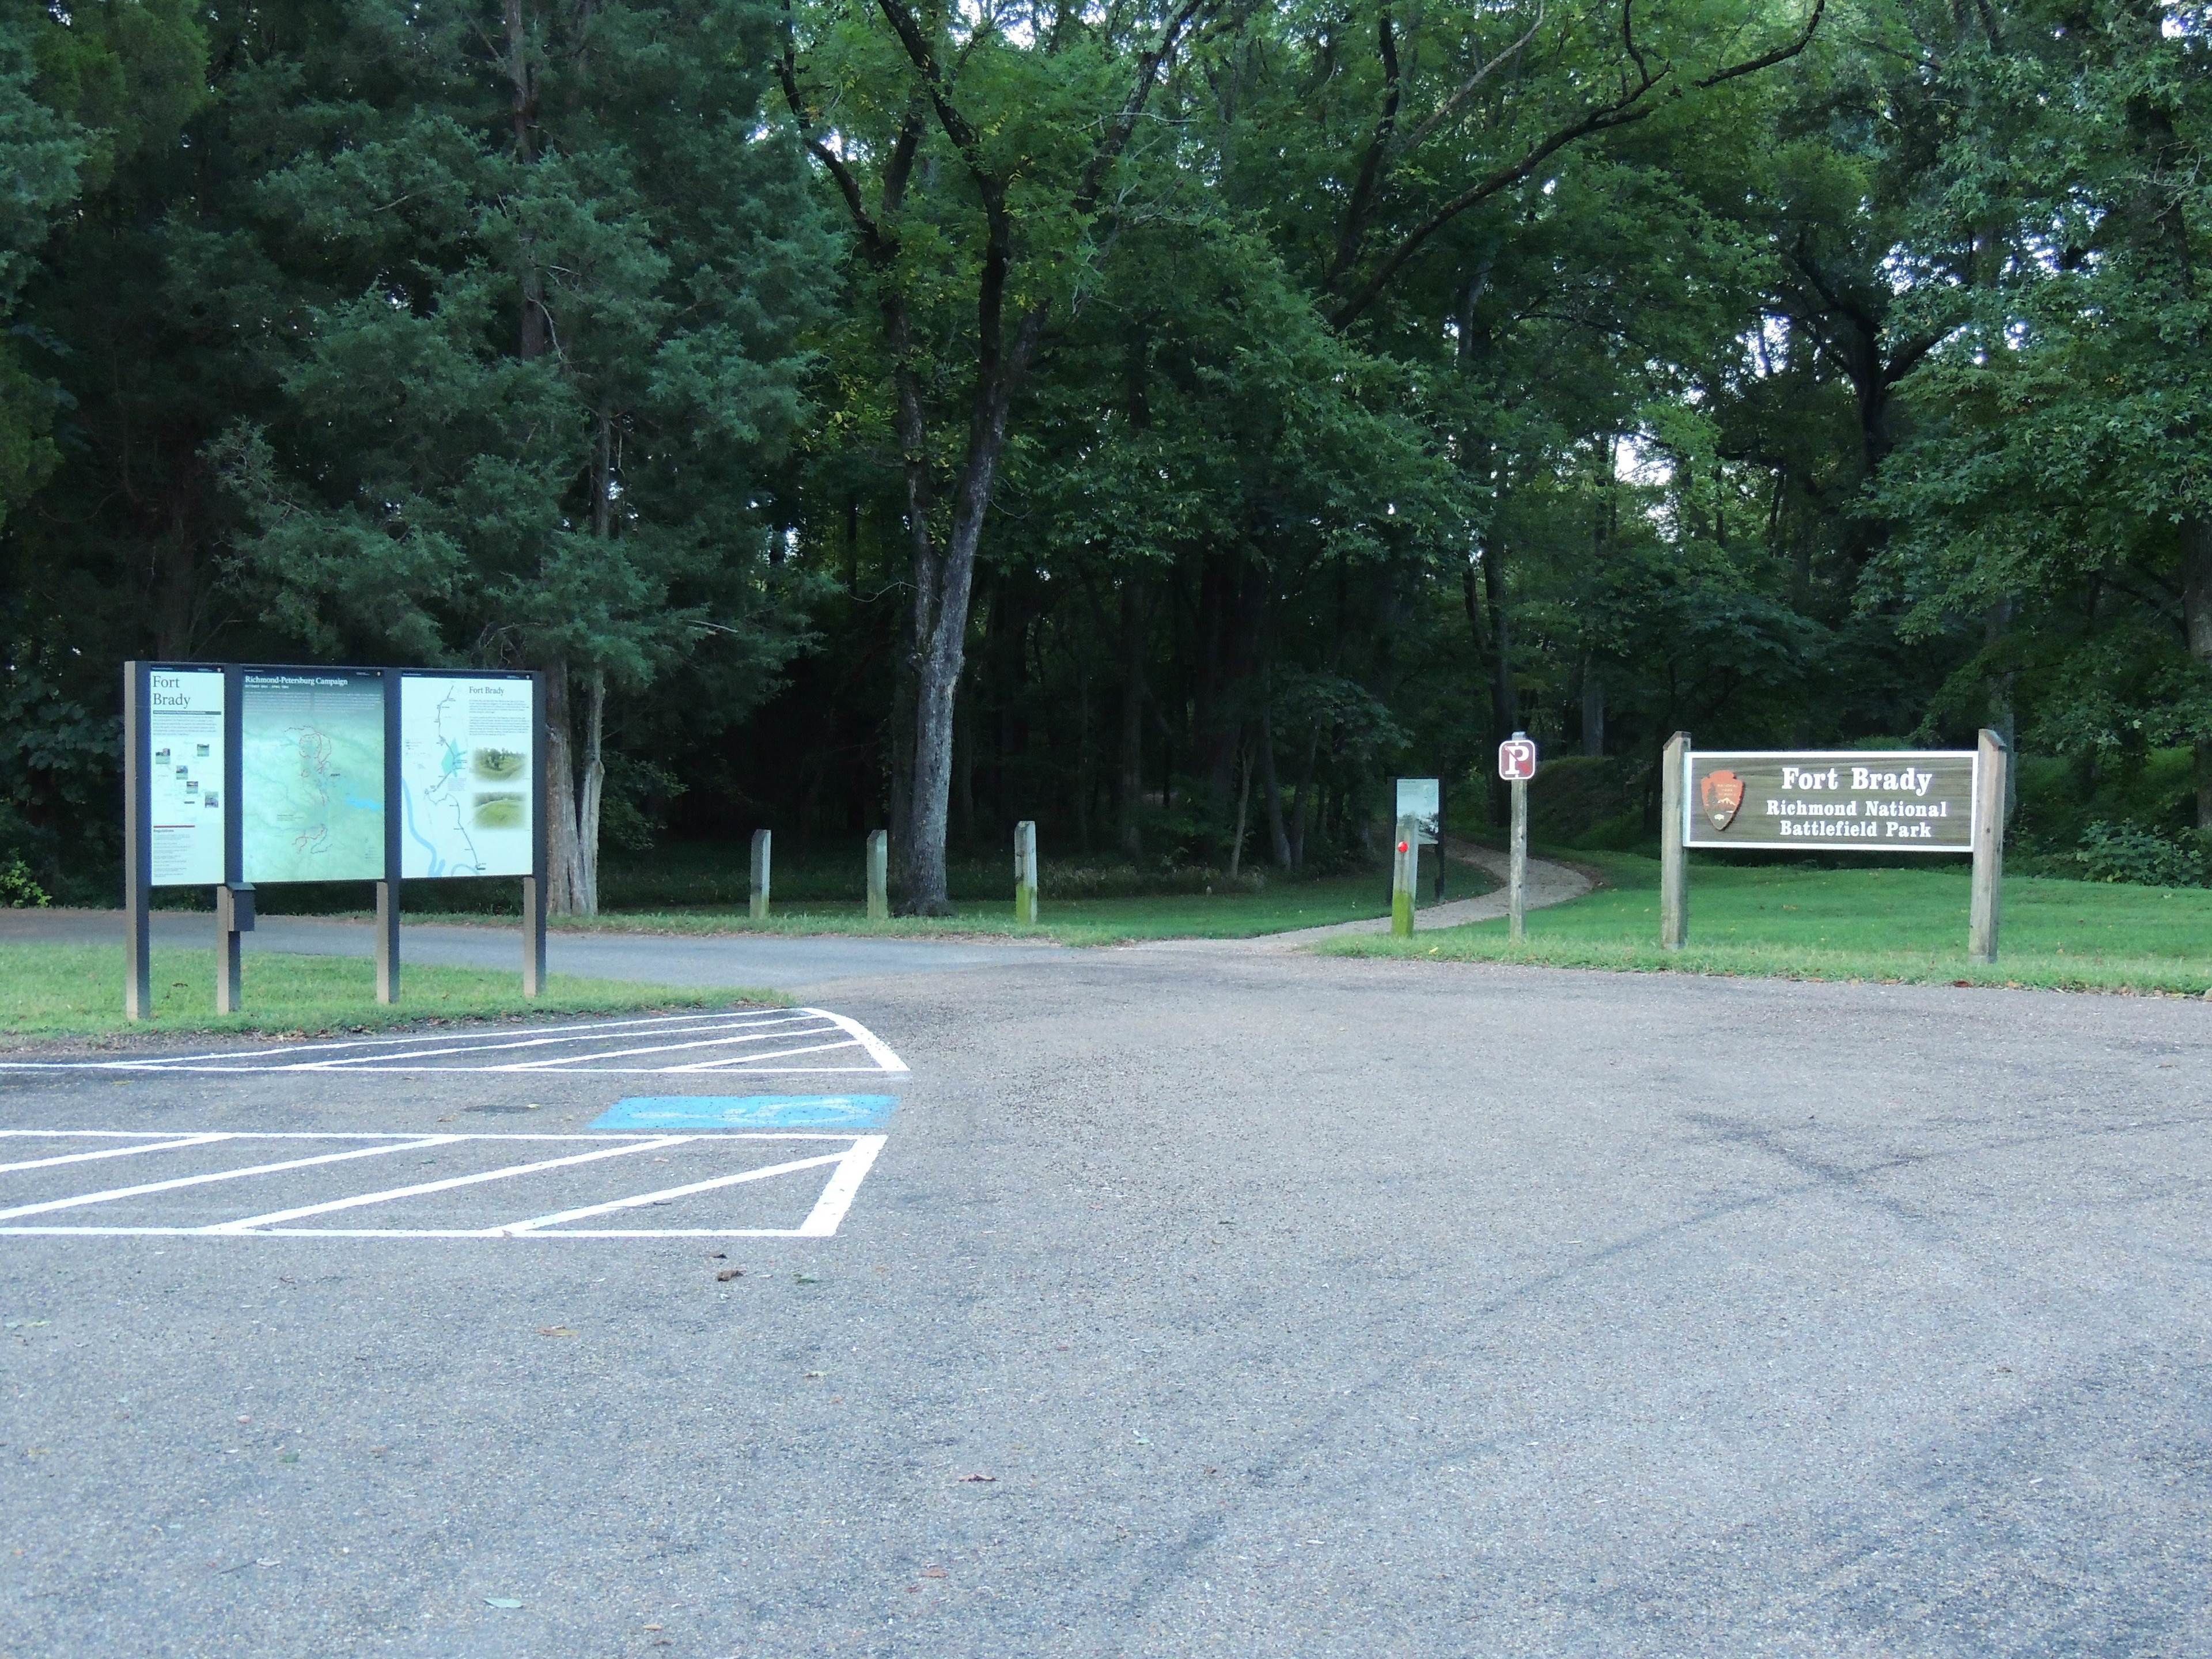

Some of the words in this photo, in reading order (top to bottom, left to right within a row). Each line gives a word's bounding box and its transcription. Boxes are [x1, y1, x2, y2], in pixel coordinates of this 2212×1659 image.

[153, 675, 180, 688] Fort
[245, 675, 315, 685] Richmond-Petersburg
[316, 677, 348, 687] Campaign
[485, 687, 504, 696] Brady
[153, 693, 191, 709] Brady
[1781, 767, 1838, 790] Fort
[1851, 767, 1933, 796] Brady
[1766, 800, 1857, 816] Richmond
[1865, 801, 1947, 817] National
[1780, 820, 1877, 836] Battlefield
[1885, 821, 1931, 837] Park
